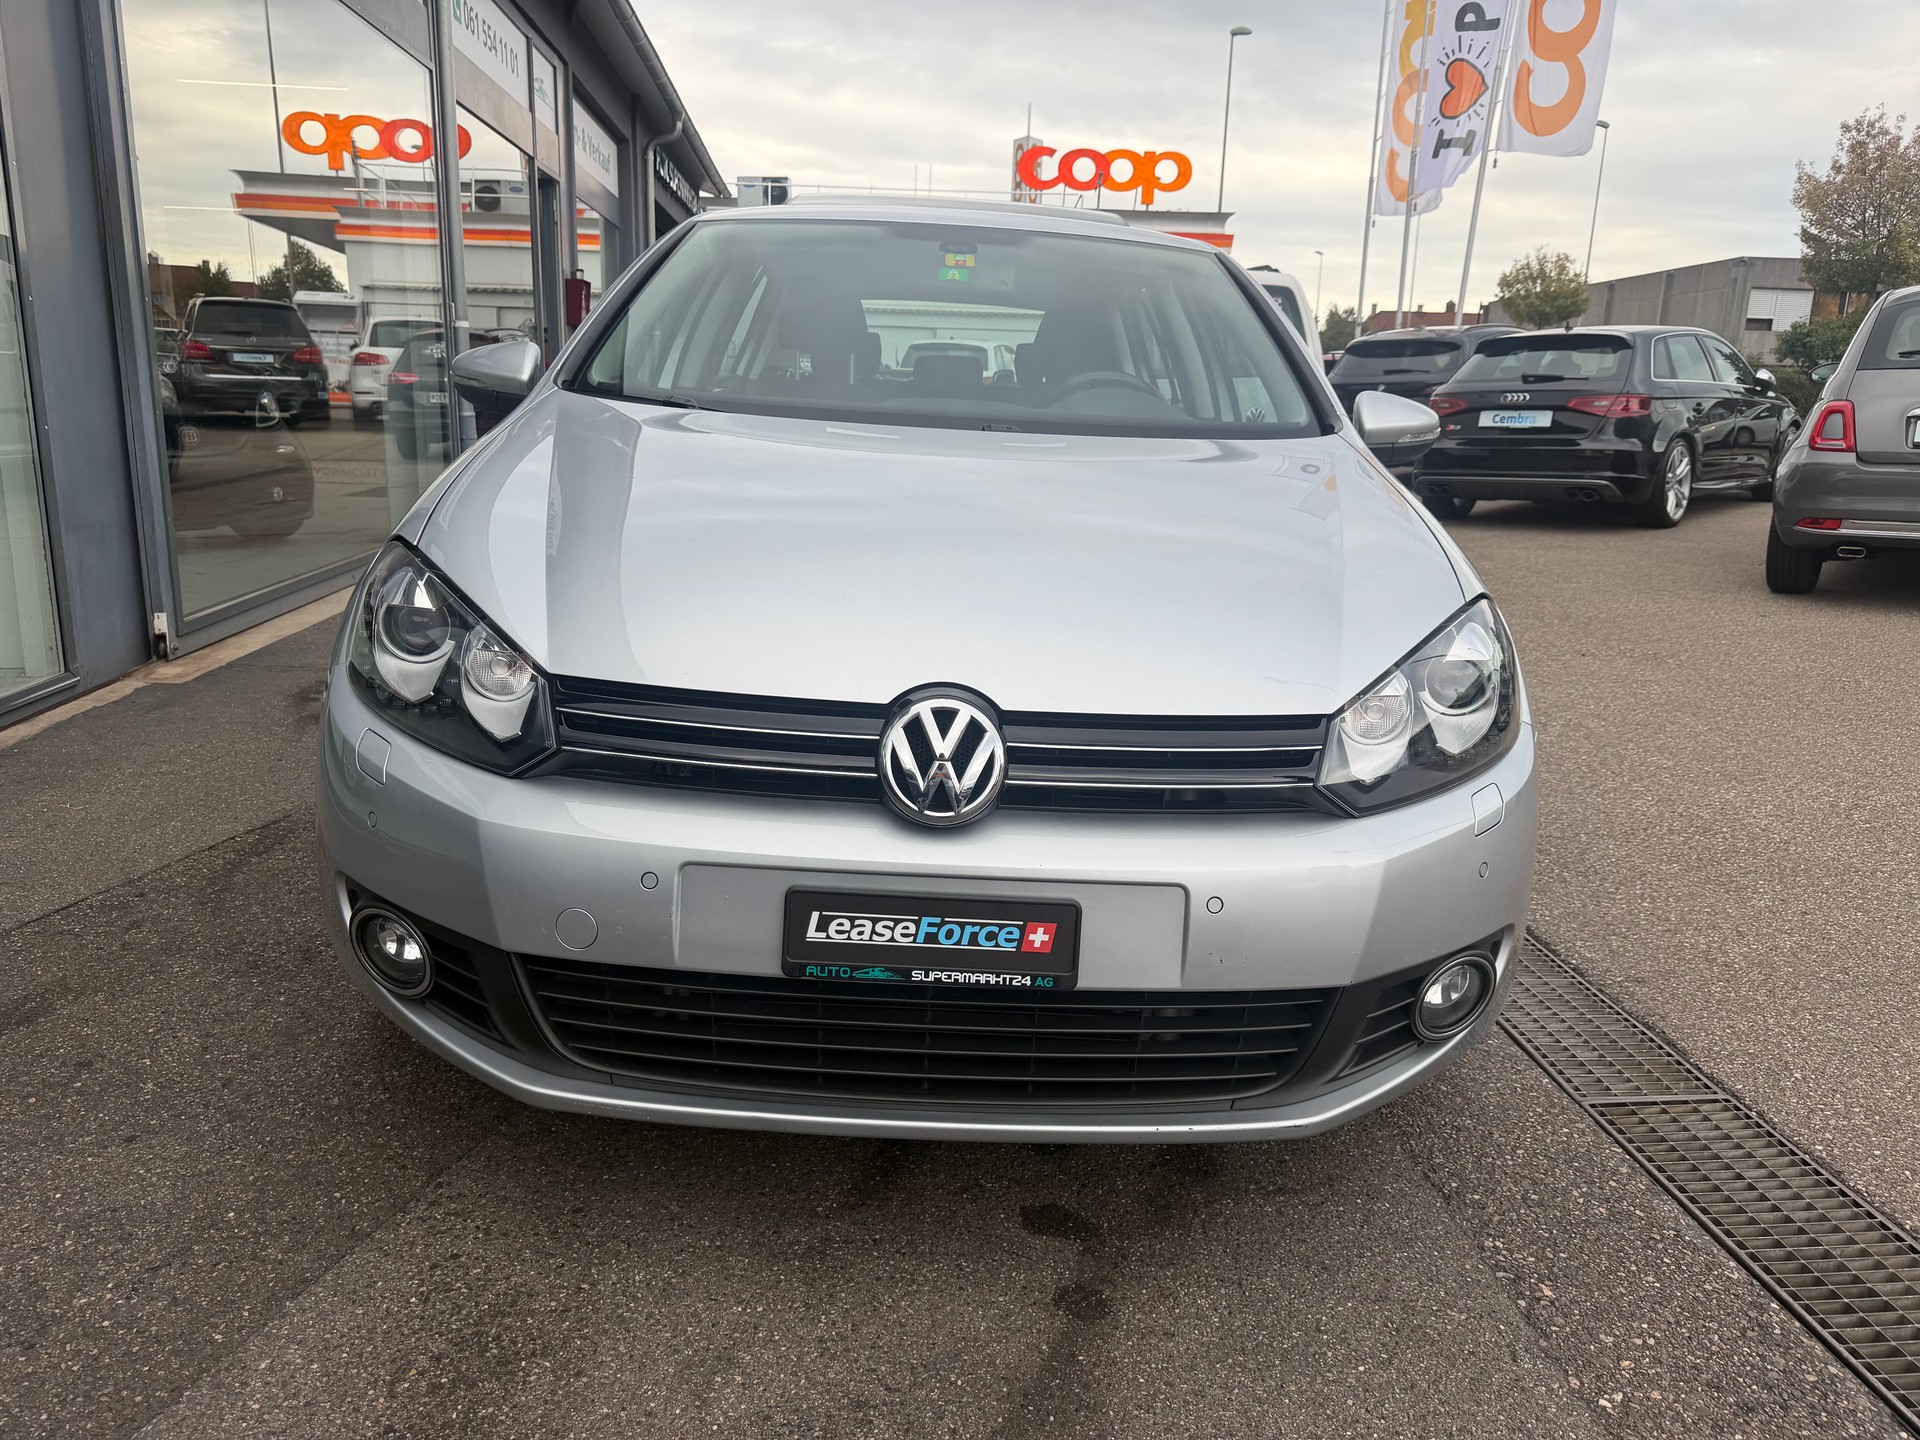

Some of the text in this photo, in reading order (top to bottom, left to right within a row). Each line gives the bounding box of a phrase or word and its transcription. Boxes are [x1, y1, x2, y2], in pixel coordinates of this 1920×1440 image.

[463, 0, 519, 79] 061 554 11 01
[587, 132, 611, 176] Verkauf
[1017, 145, 1193, 206] coop
[1492, 413, 1537, 425] Cembra
[806, 911, 1020, 948] LeaseForce
[806, 965, 1054, 988] AUTO SUPERMARKT24 AG
